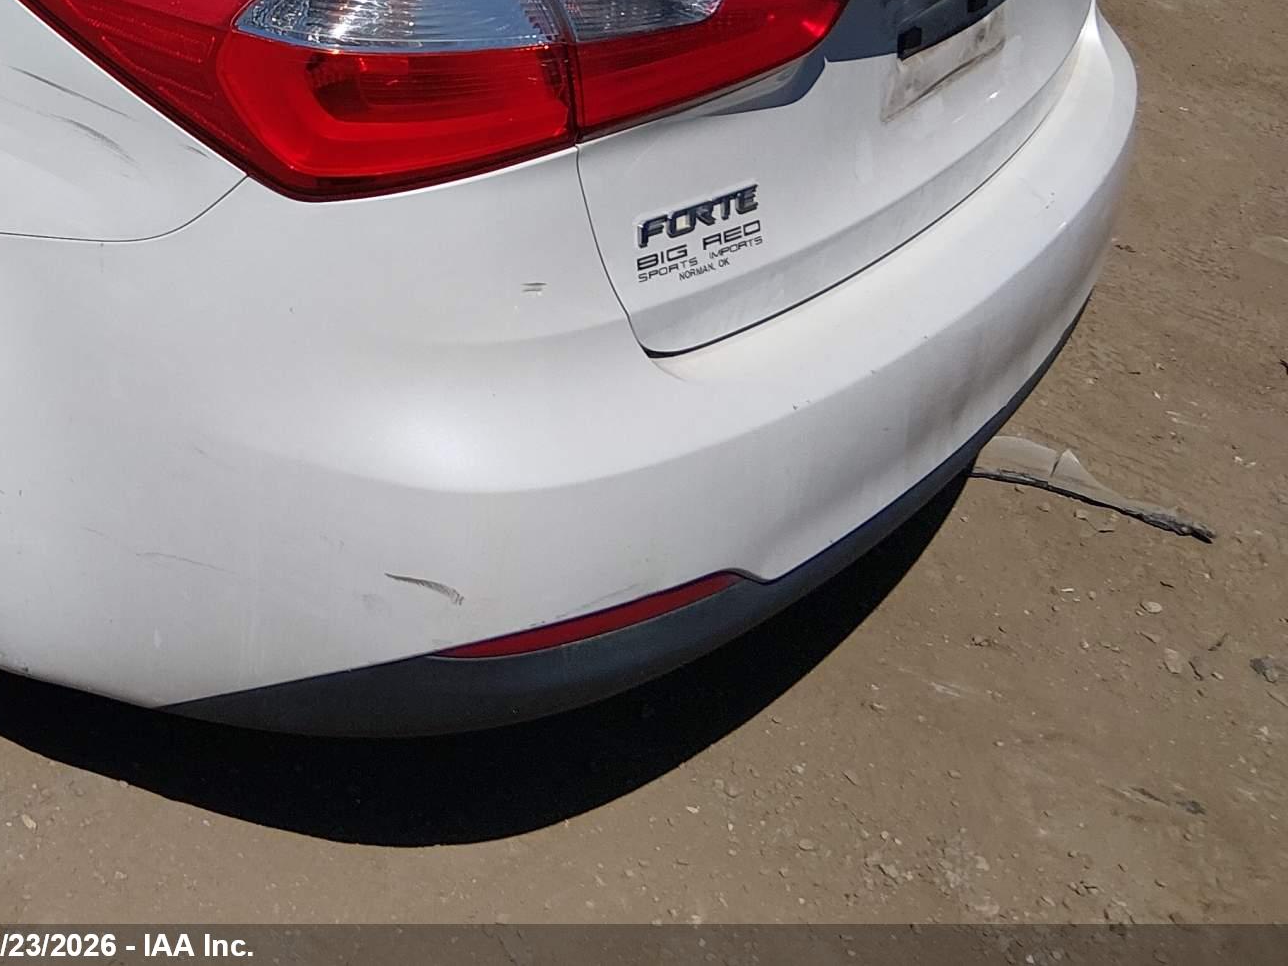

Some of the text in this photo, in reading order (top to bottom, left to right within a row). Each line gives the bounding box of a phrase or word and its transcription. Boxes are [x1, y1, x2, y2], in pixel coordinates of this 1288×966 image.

[637, 184, 758, 248] FORTE
[637, 244, 688, 271] BIG
[638, 235, 763, 283] SPORTS IMPORTS
[718, 258, 730, 268] OK
